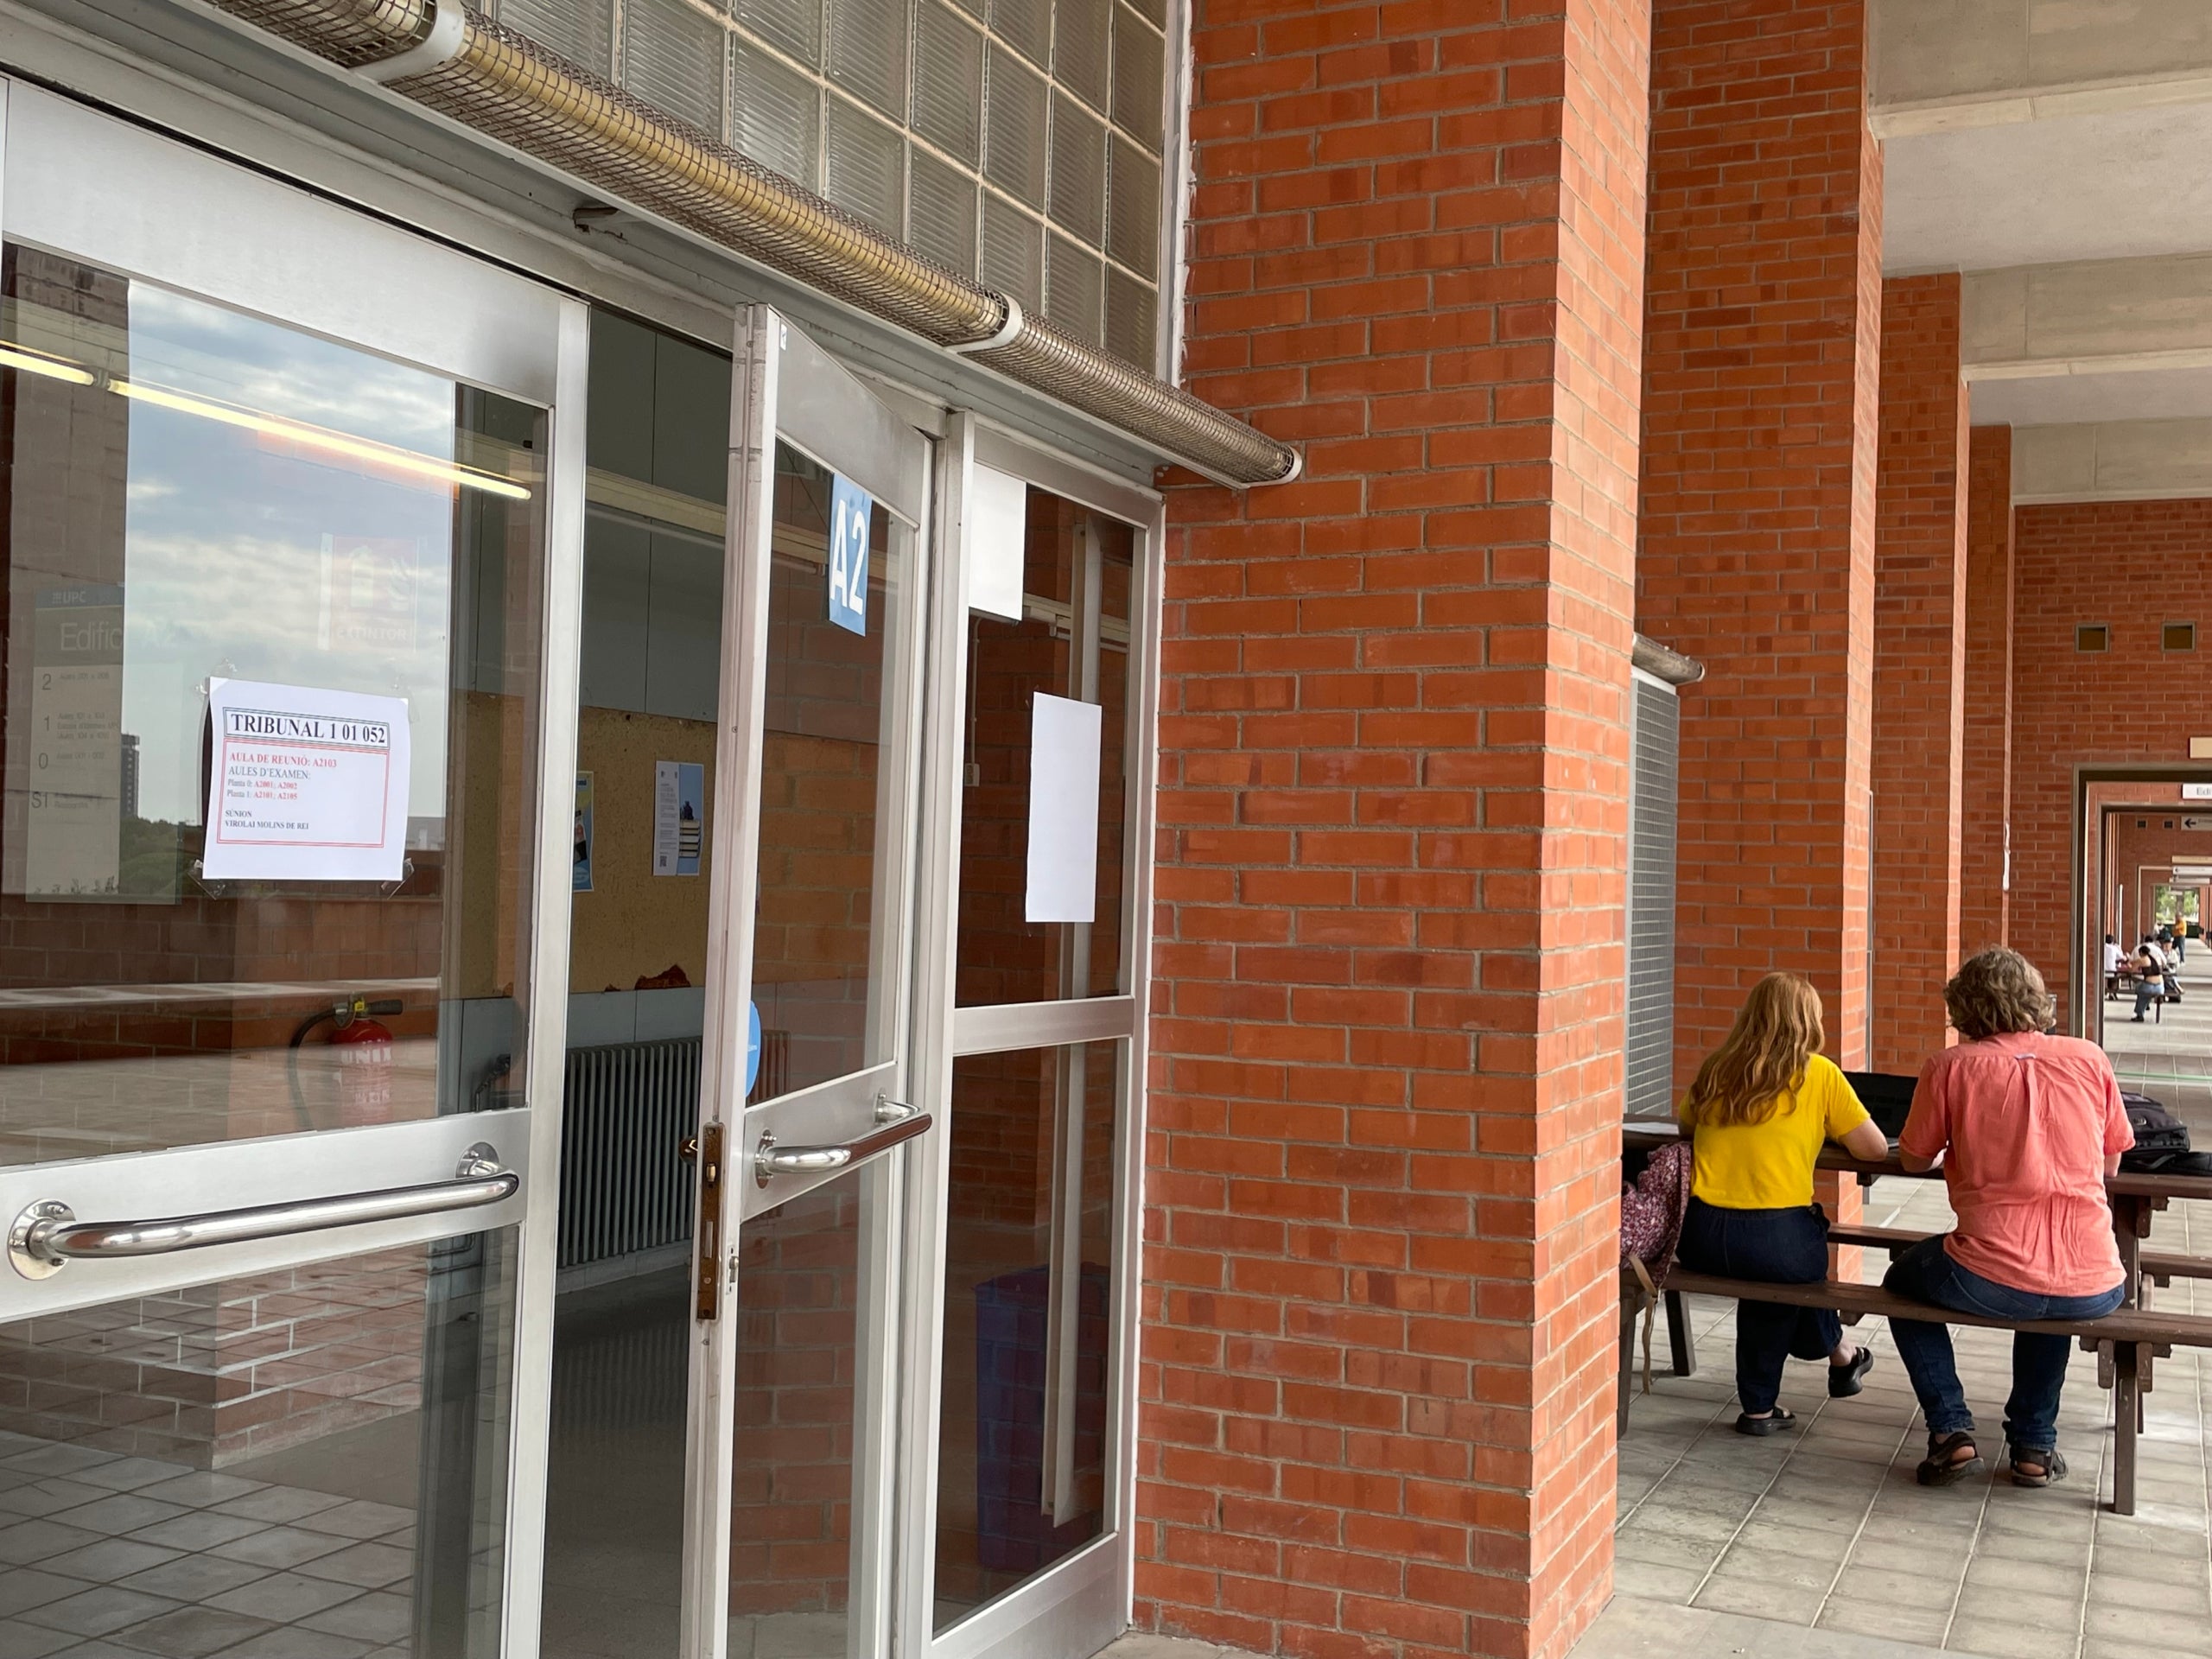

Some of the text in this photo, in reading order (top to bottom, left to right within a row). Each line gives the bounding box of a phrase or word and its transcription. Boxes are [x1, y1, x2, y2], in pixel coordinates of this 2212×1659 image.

[830, 499, 866, 615] A2
[41, 673, 52, 690] 2
[43, 714, 49, 732] 1
[231, 714, 385, 743] TRIBUNAL 1 01 052
[38, 753, 48, 770] 0
[230, 752, 255, 763] AULA
[257, 753, 270, 764] DE
[313, 758, 337, 768] A2103
[229, 766, 257, 777] AULES
[225, 820, 256, 829] VIROLAI
[257, 821, 285, 830] MOLINS
